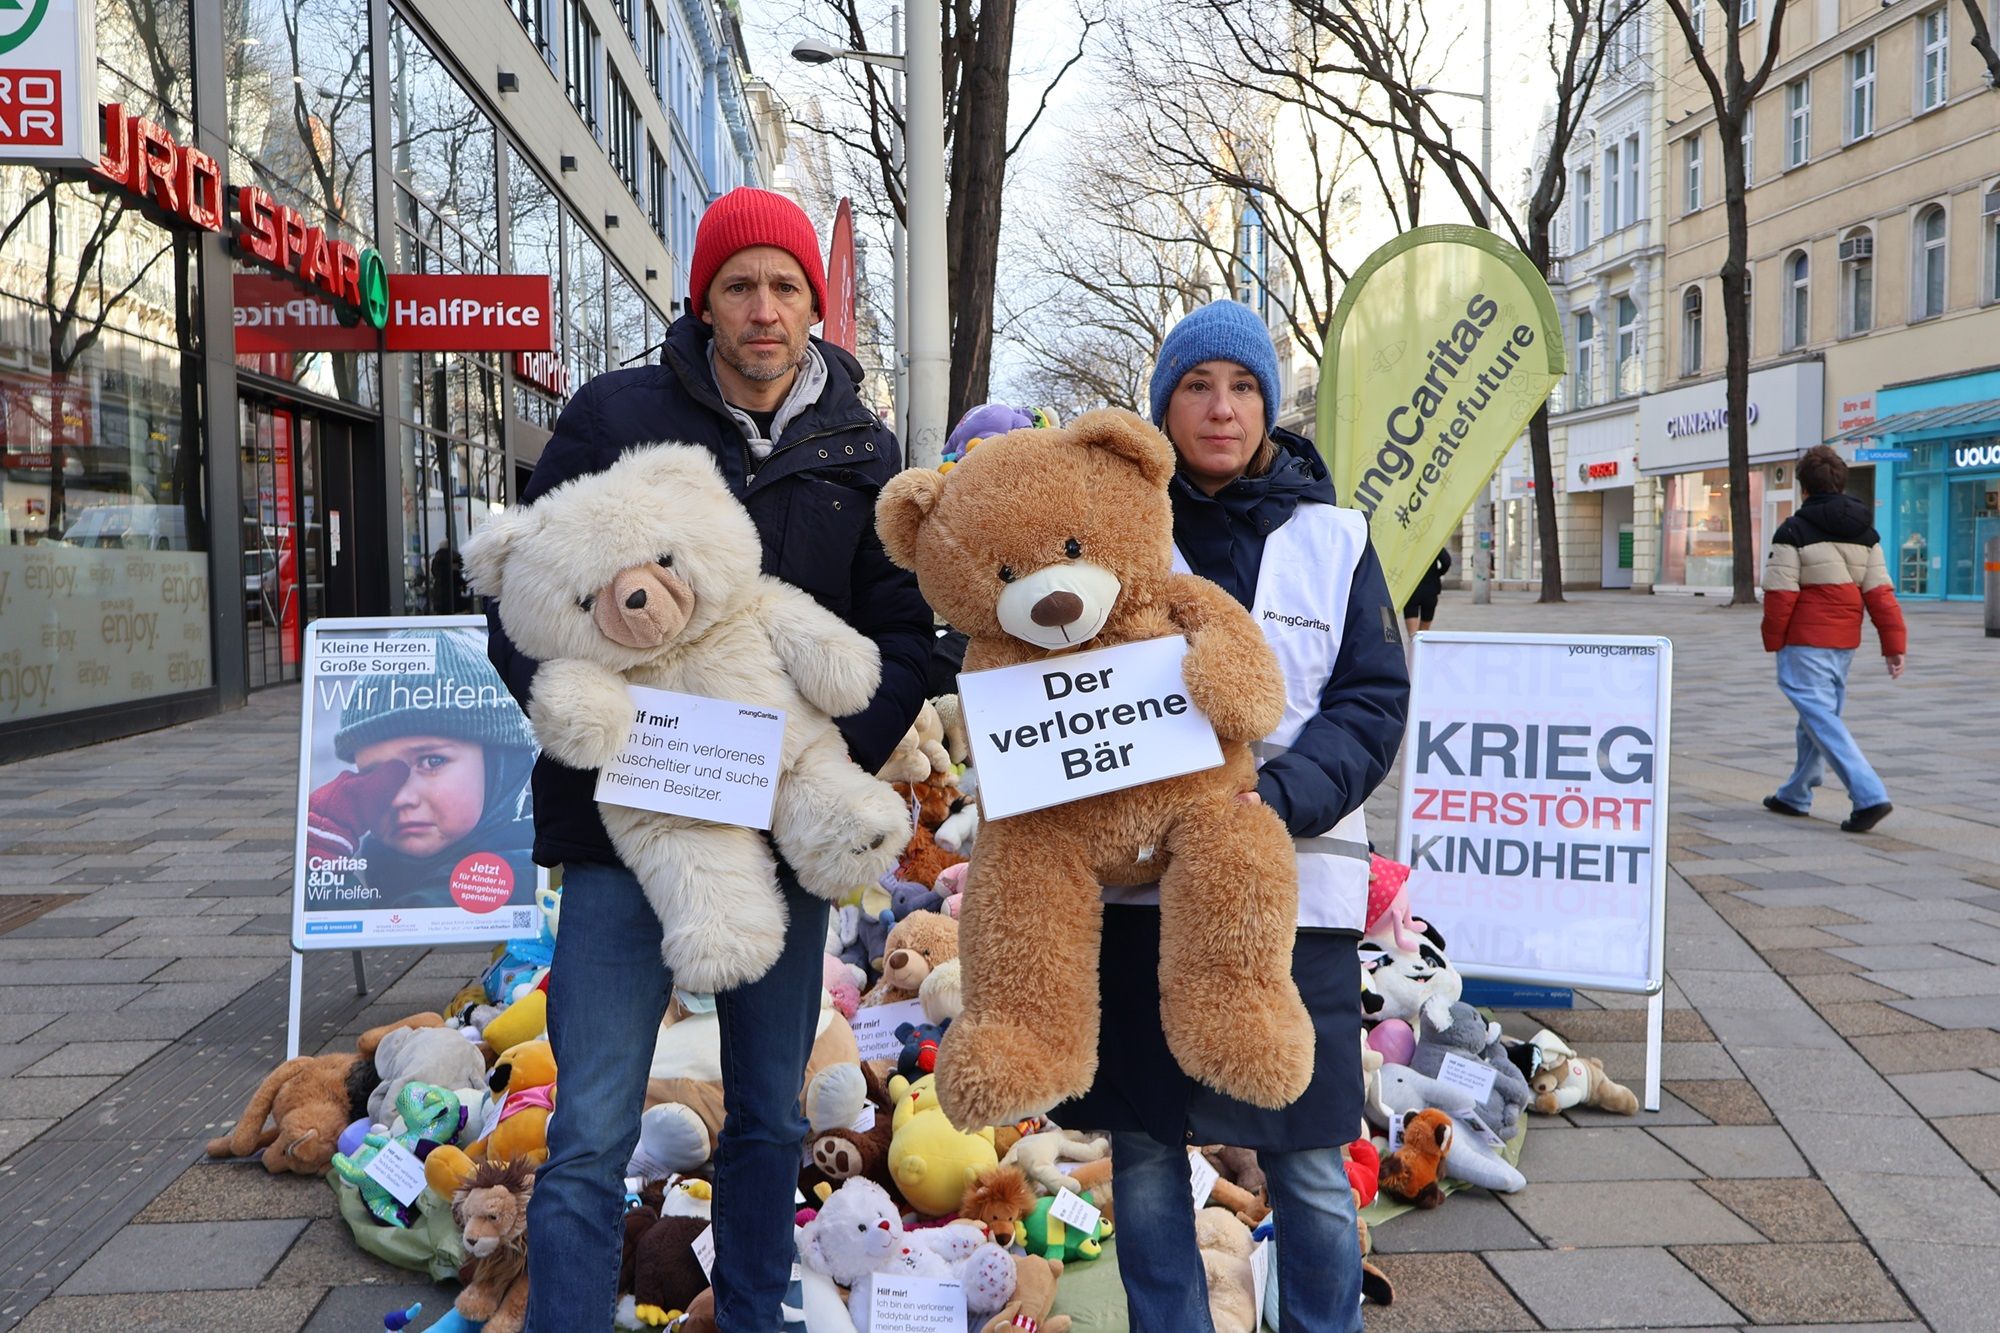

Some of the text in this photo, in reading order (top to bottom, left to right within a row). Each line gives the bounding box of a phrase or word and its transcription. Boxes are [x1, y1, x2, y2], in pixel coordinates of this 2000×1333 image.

[239, 186, 361, 306] SPAR
[395, 299, 540, 326] HalfPrice
[1394, 324, 1535, 529] #createfuture
[1589, 462, 1618, 478] BOSCH
[1263, 610, 1331, 632] youngCaritas
[321, 641, 431, 653] Kleine Herzen.
[320, 659, 431, 674] Große Sorgen.
[1043, 668, 1114, 701] Der
[319, 678, 507, 711] Wir helfen.
[649, 714, 679, 729] mir!
[738, 708, 778, 721] youngCaritas
[989, 692, 1188, 753] verlorene
[642, 732, 663, 748] bin
[667, 738, 689, 752] ein
[693, 744, 765, 766] verlorenes
[1415, 721, 1654, 784] KRIEG
[1061, 741, 1134, 780] Bär
[694, 766, 722, 779] und
[725, 771, 769, 788] suche
[606, 772, 722, 802] meinen Besitzer.
[1412, 787, 1651, 831] ZERSTÖRT
[309, 856, 368, 871] Caritas
[1411, 834, 1650, 884] KINDHEIT
[470, 862, 500, 875] Jetzt
[308, 871, 345, 887] &Du
[472, 875, 497, 885] Kinder
[498, 878, 506, 886] in
[308, 885, 382, 900] Wir helfen.
[452, 881, 509, 896] Krisengebieten
[461, 893, 497, 903] spenden!
[864, 1019, 880, 1028] mir!
[877, 1287, 891, 1296] Hilf
[892, 1290, 908, 1298] mir!
[877, 1299, 888, 1307] Ich
[890, 1300, 901, 1308] bin
[876, 1311, 911, 1321] Teddybär
[931, 1315, 954, 1323] suche
[876, 1322, 904, 1332] meinen
